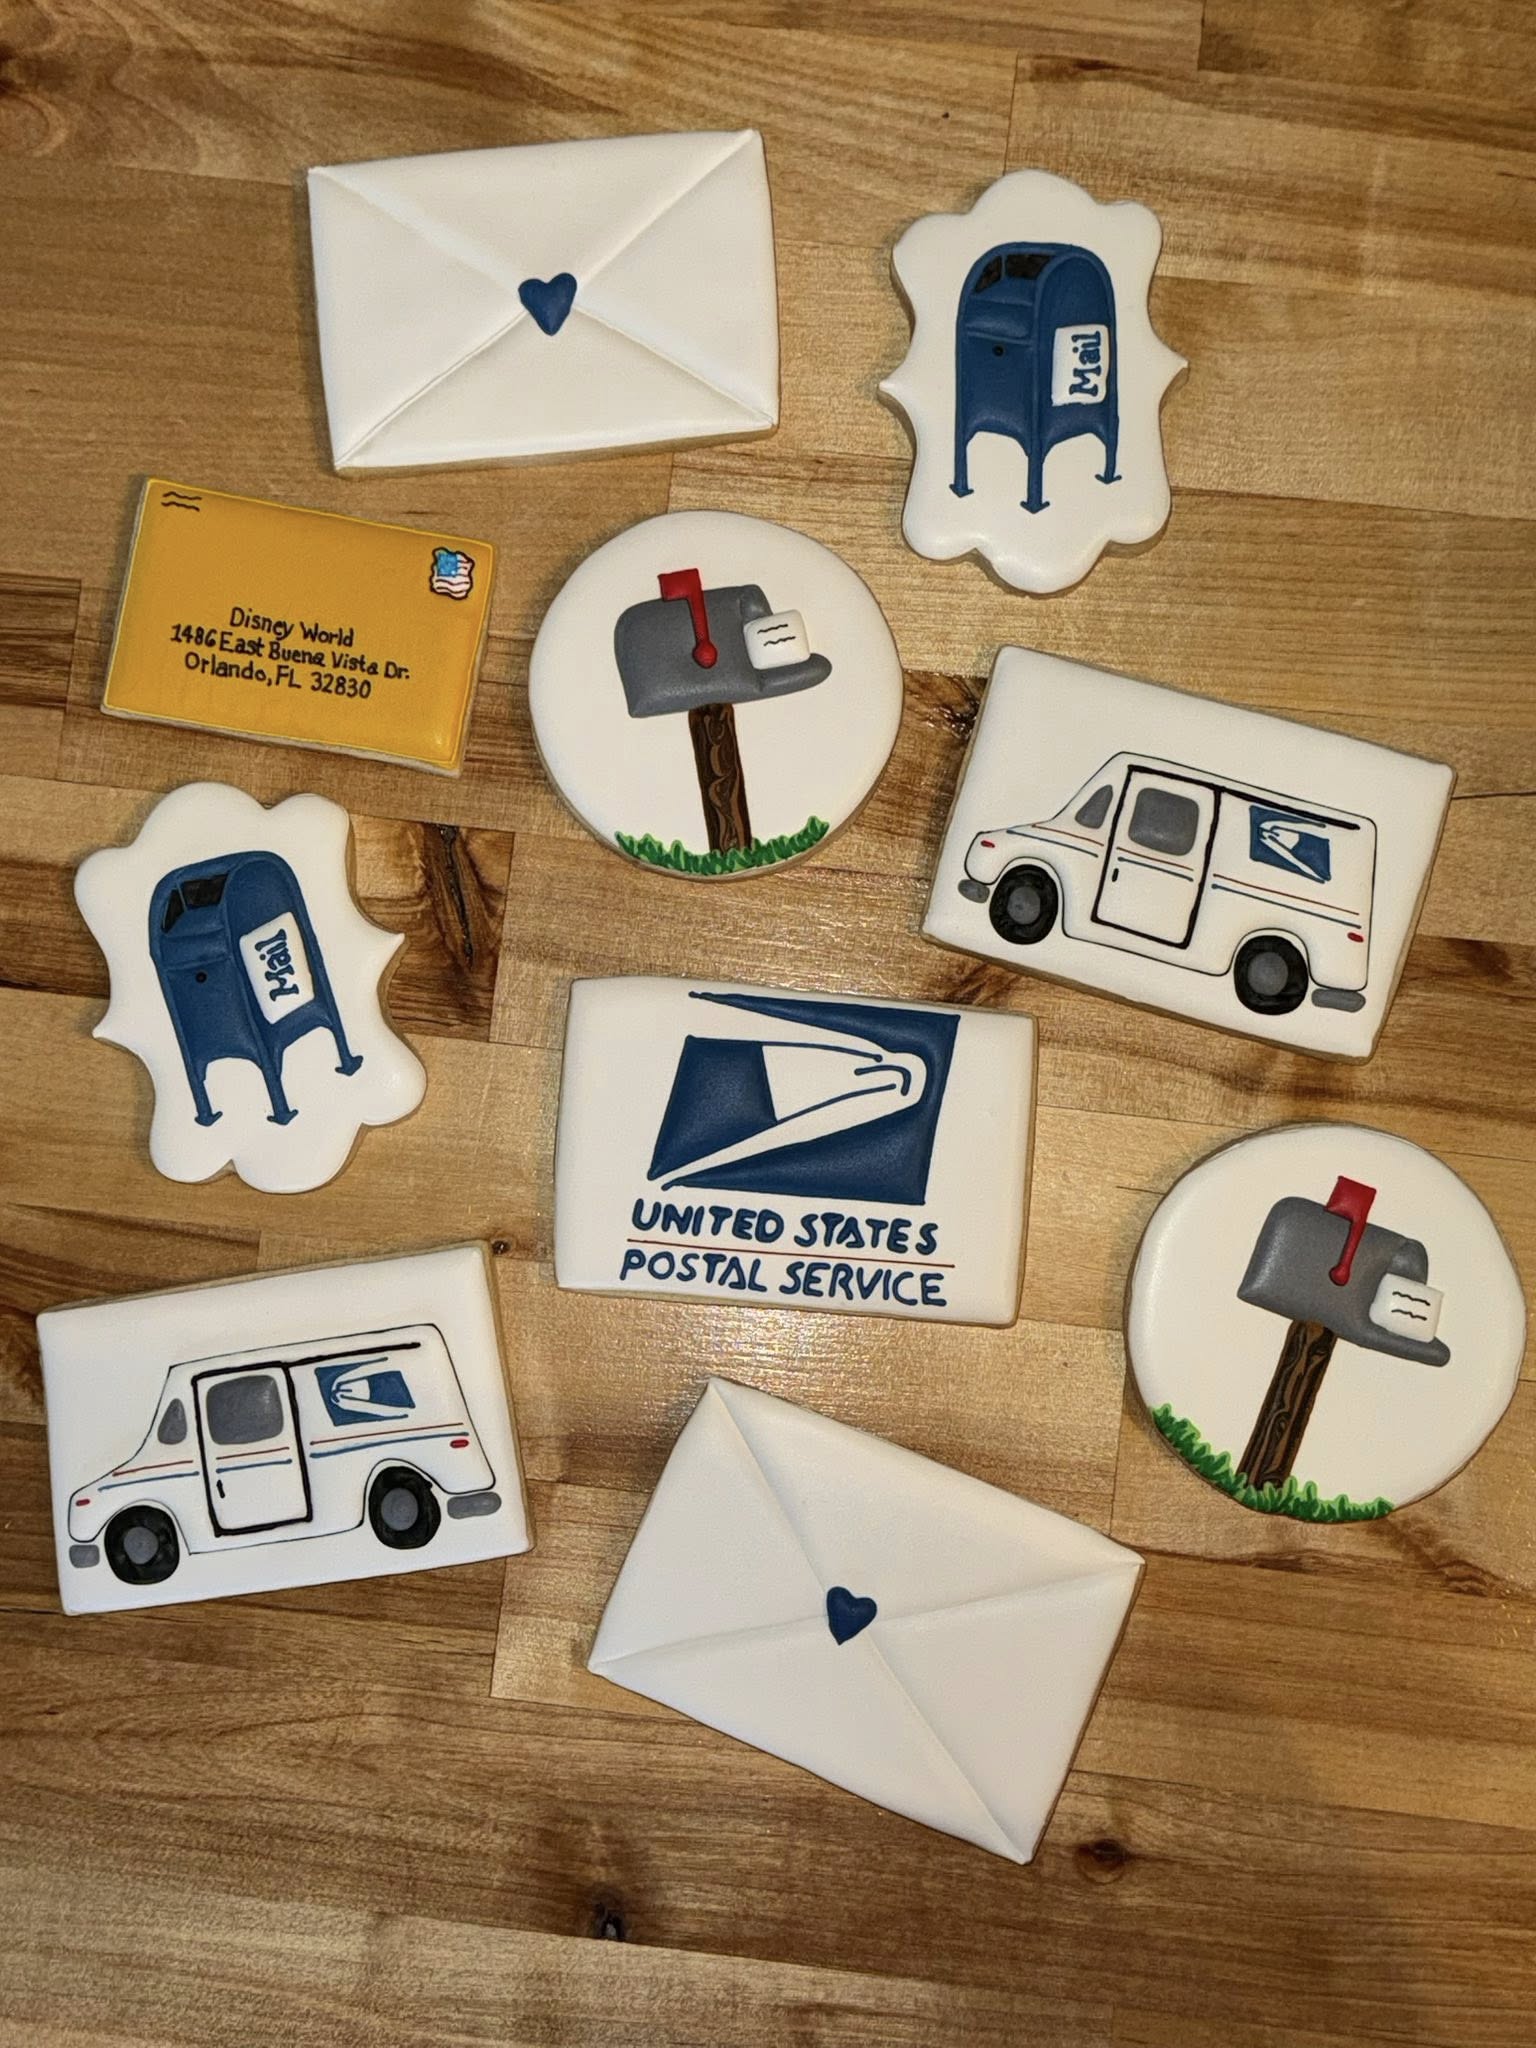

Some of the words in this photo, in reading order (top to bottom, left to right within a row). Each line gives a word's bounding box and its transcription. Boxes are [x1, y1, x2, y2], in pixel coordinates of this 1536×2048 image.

[1069, 330, 1102, 397] Mail
[170, 623, 217, 647] 1486
[219, 631, 265, 657] East
[268, 641, 326, 667] Buena
[331, 651, 379, 675] Vista
[384, 661, 410, 679] Dr.
[229, 606, 294, 641] Disney
[300, 621, 354, 647] World
[310, 671, 371, 699] 32830
[255, 928, 299, 1002] Mail
[631, 1198, 784, 1243] UNITED
[794, 1211, 939, 1255] STATES
[619, 1249, 767, 1293] POSTAL
[779, 1261, 947, 1306] SERVICE
